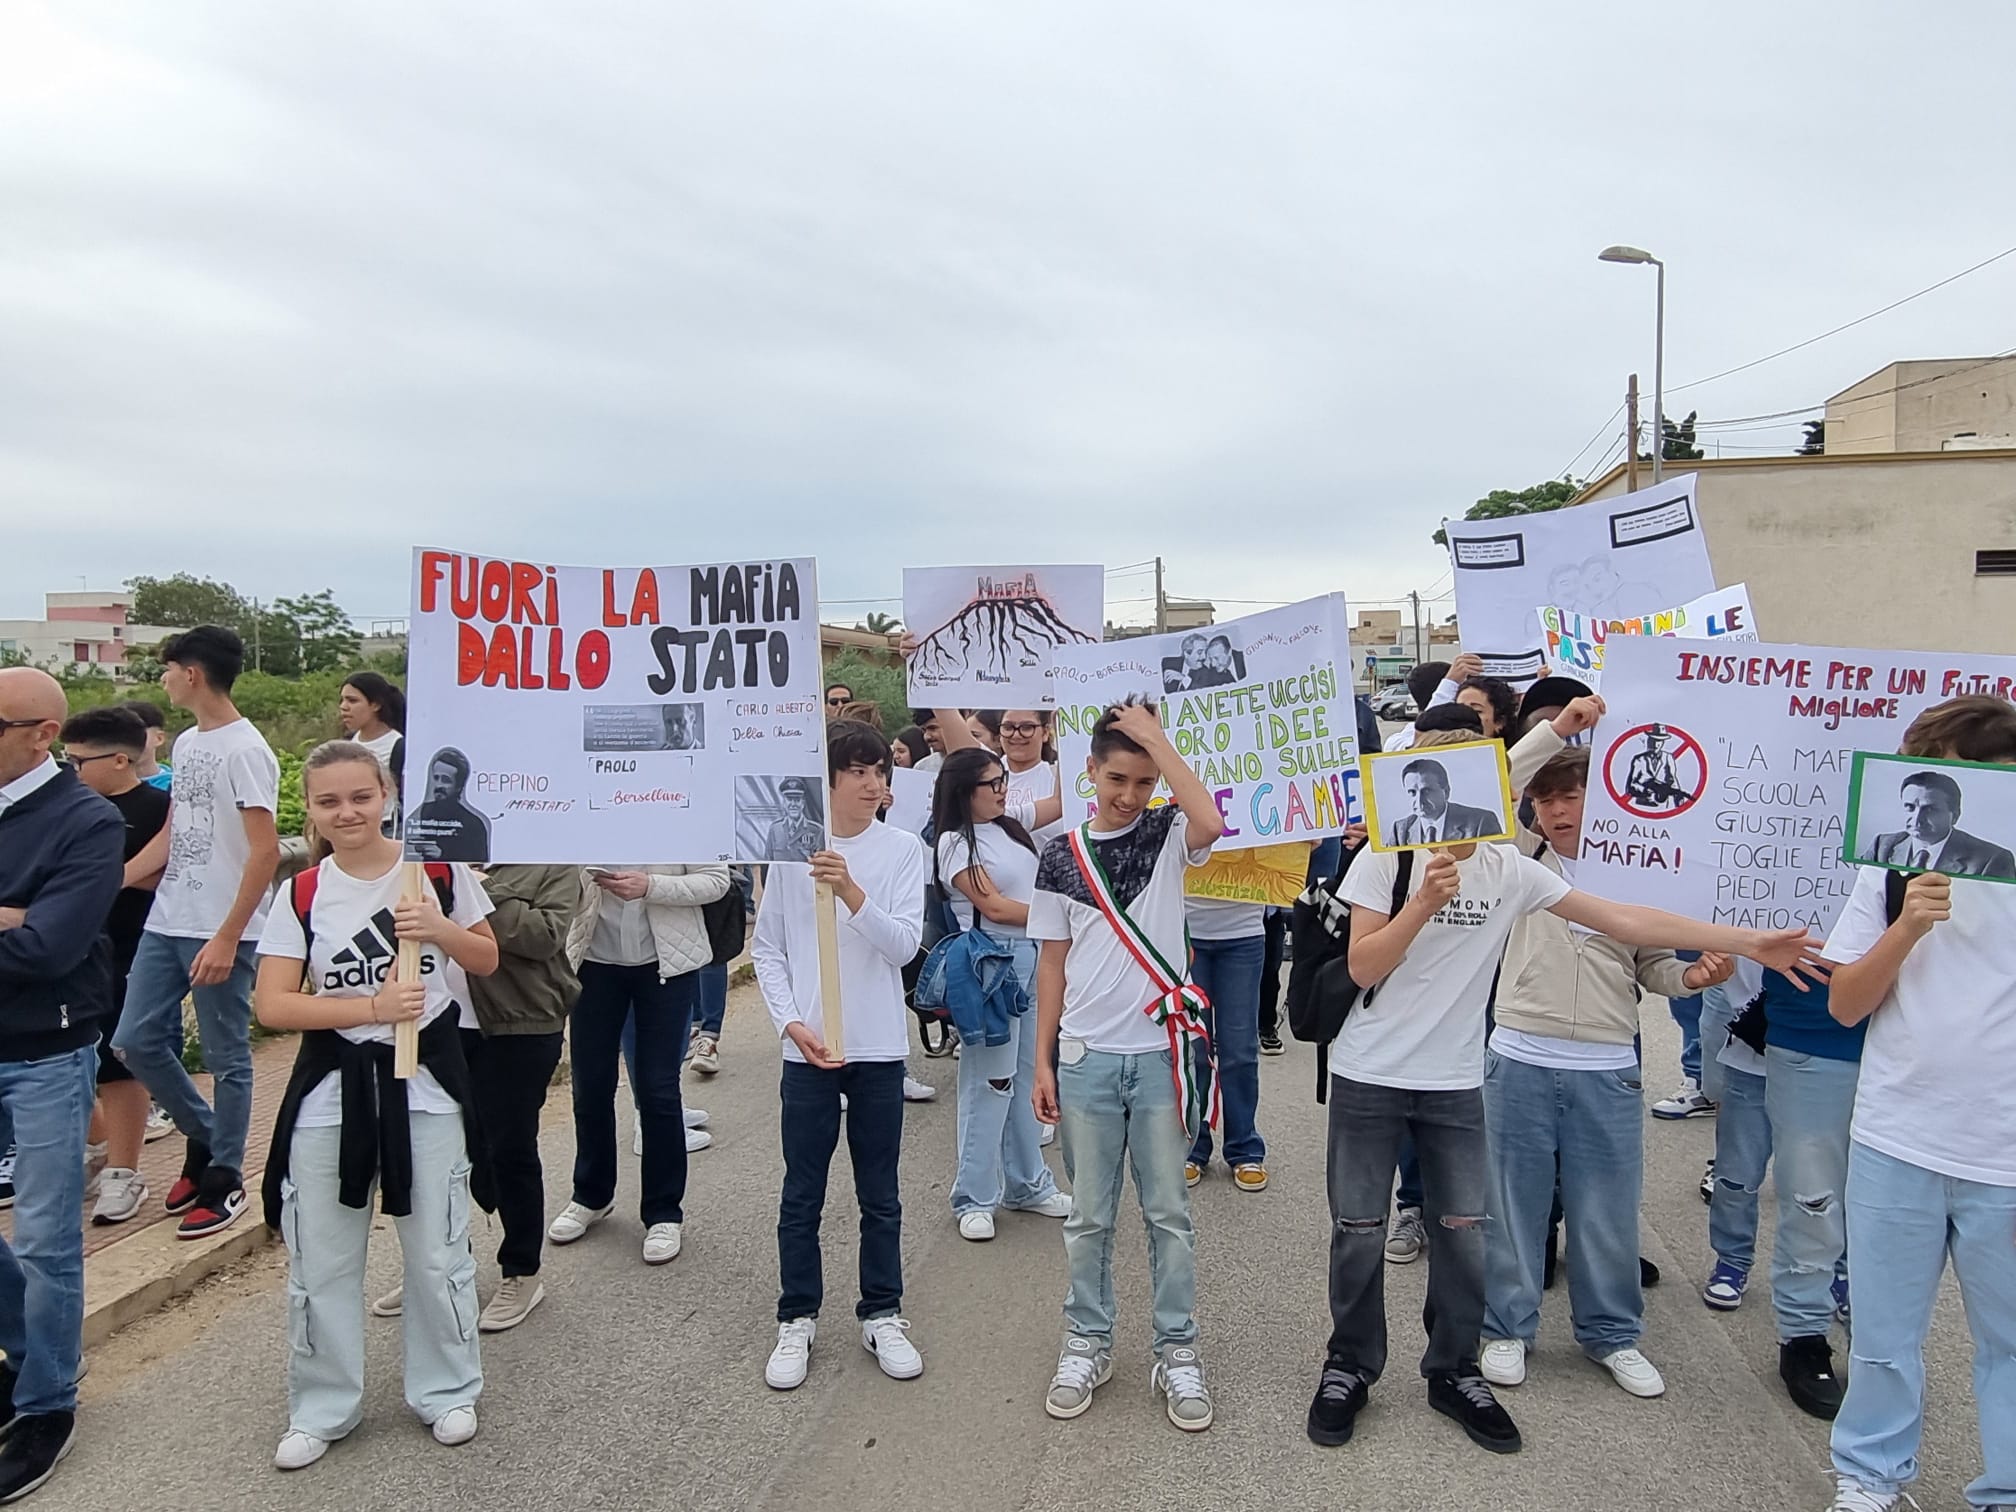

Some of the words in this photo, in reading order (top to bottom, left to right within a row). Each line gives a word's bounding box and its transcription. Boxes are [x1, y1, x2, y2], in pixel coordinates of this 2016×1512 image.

[602, 568, 660, 627] LA
[1543, 606, 1582, 640] GLI
[1706, 606, 1744, 637] LE
[457, 622, 612, 690] DALLO
[647, 626, 790, 695] STATO
[1826, 661, 1873, 691] PER
[1887, 667, 1926, 696] UN
[736, 703, 769, 717] CARLO
[775, 702, 814, 714] ALBERTO
[1176, 683, 1266, 728] AVETE
[1175, 722, 1231, 756] ORO
[1278, 736, 1355, 777] SULLE
[595, 759, 637, 773] PAOLO
[1250, 769, 1363, 836] GAMBE
[1723, 776, 1827, 808] SCUOLA
[1592, 819, 1619, 834] NO
[1628, 823, 1671, 840] ALLA
[324, 953, 436, 990] adids
